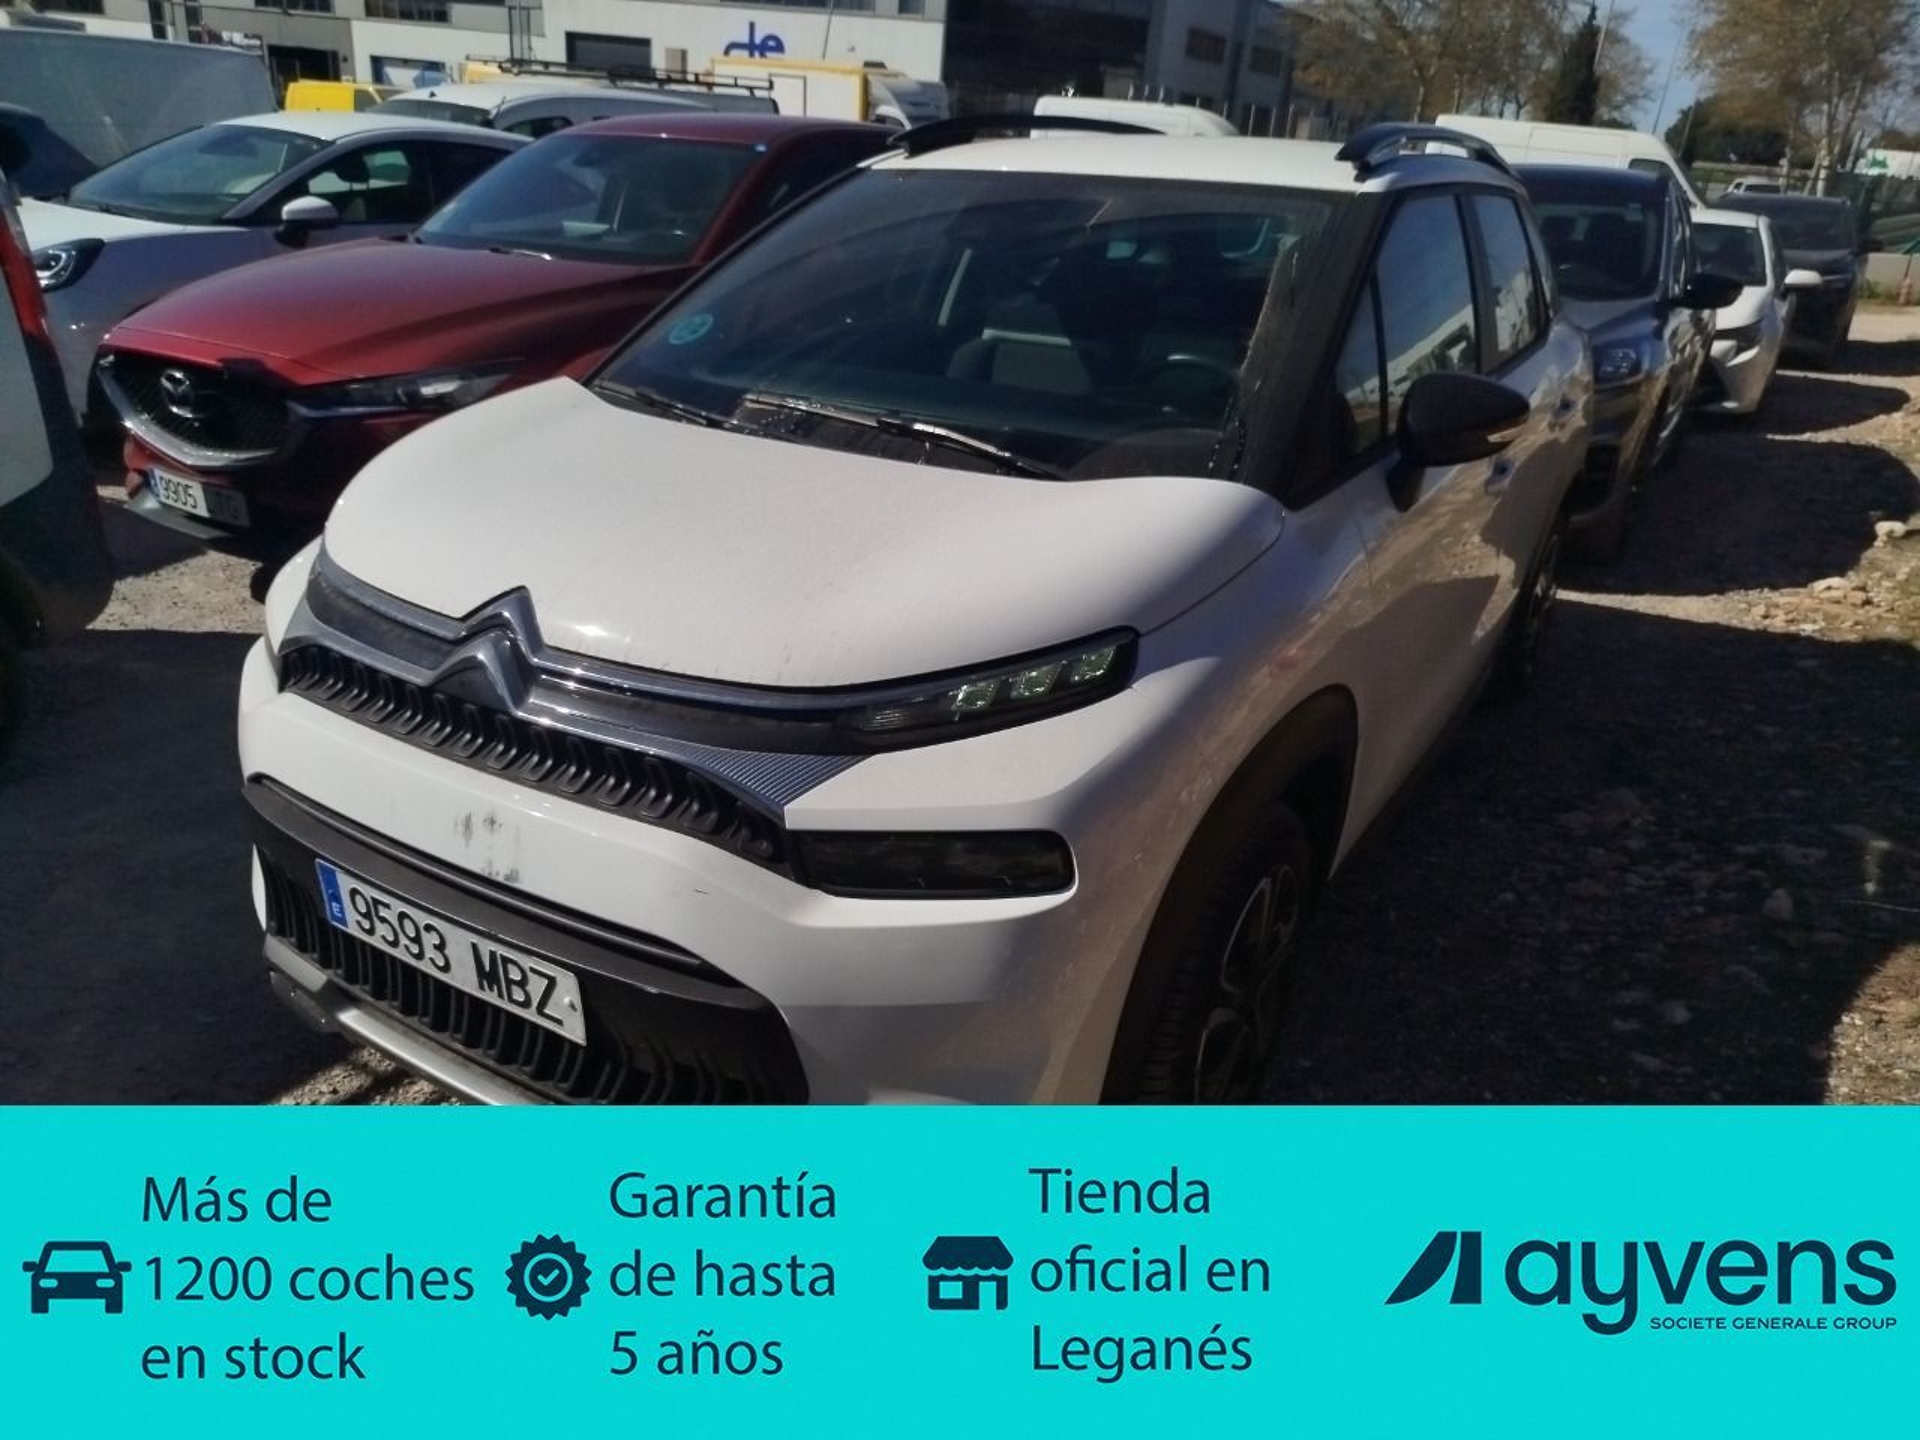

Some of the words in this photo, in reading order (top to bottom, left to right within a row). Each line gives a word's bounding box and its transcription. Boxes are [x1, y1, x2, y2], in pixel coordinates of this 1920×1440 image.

[159, 475, 198, 510] 9905
[350, 887, 452, 975] 9593
[470, 939, 564, 1027] MBZ
